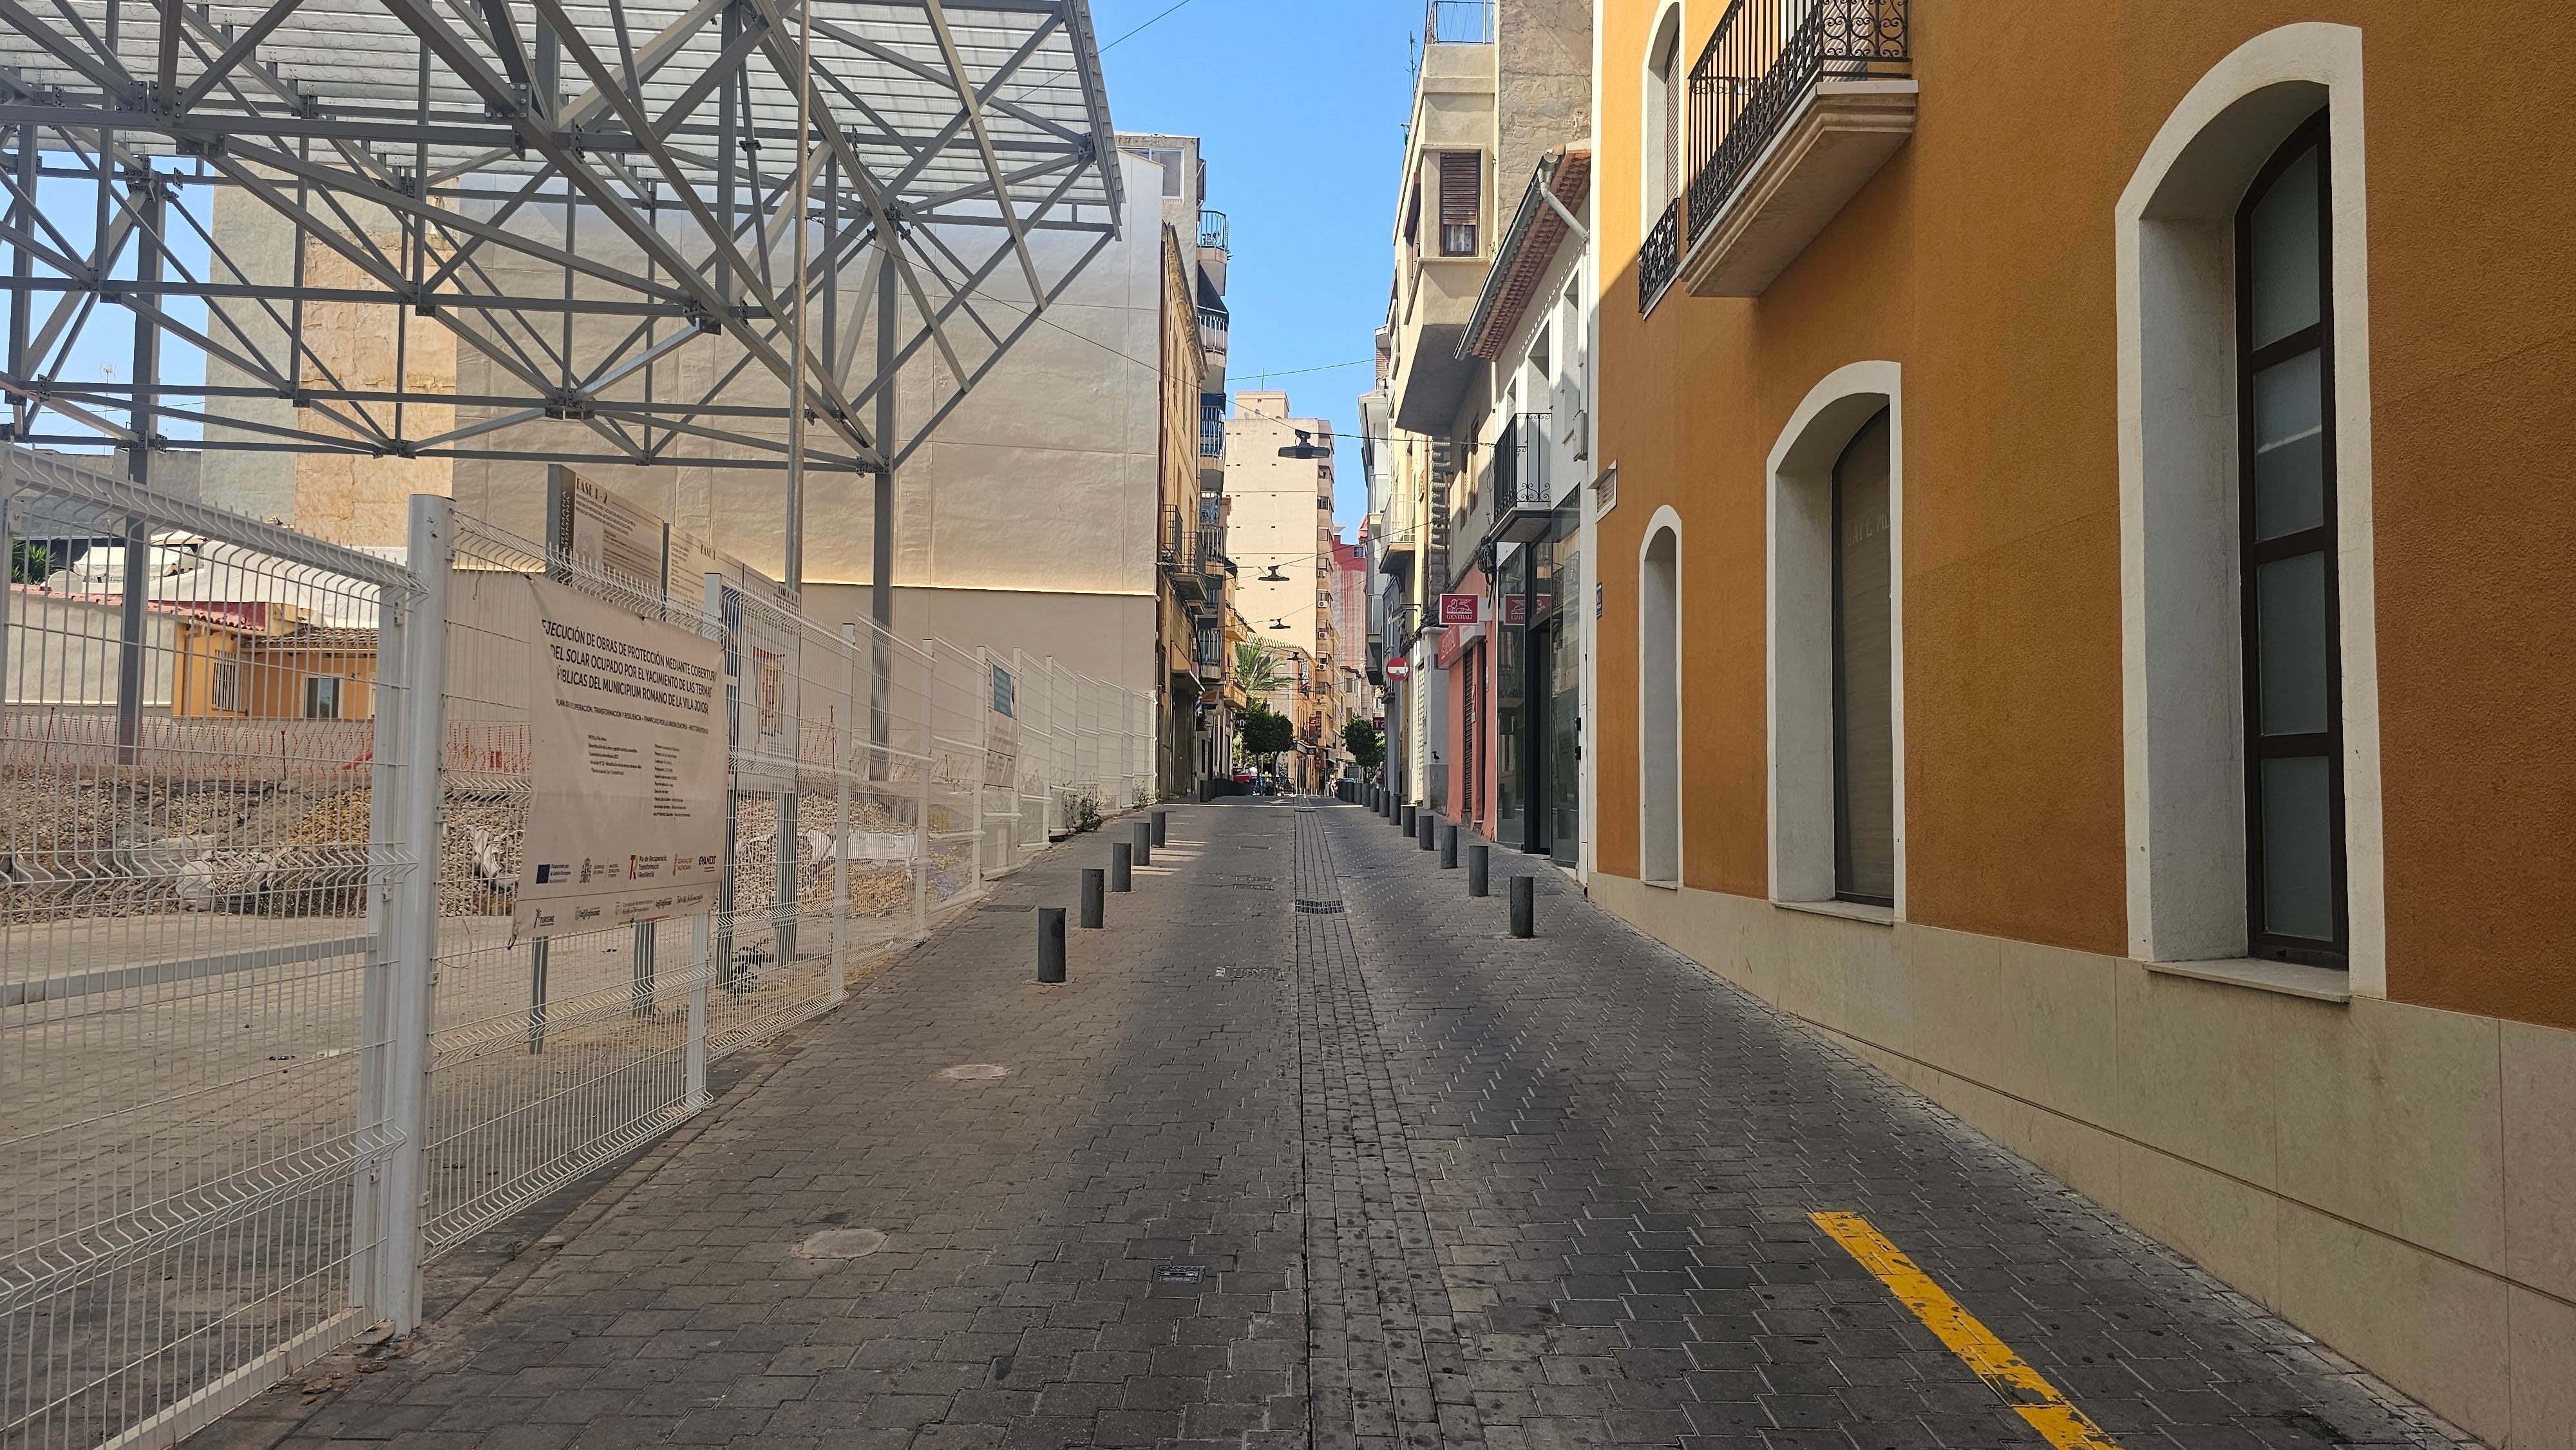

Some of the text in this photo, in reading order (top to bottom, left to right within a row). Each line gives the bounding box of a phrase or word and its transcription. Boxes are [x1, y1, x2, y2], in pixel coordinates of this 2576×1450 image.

[576, 477, 593, 498] FASE
[542, 619, 585, 645] EJECUCIÓN
[587, 632, 595, 648] DE
[596, 636, 618, 654] OBRAS
[619, 642, 627, 656] DE
[628, 645, 664, 667] PROTECCIÓN
[665, 656, 690, 675] MEDIANTE
[551, 644, 564, 661] DEL
[566, 648, 590, 667] SOLAR
[591, 655, 623, 675] OCUPADO
[624, 663, 637, 679] POR
[638, 667, 645, 681] EL
[645, 668, 678, 689] YACIMIENTO
[679, 678, 686, 691] DE
[687, 681, 695, 693] LAS
[556, 699, 565, 708] PLAN
[589, 675, 601, 690] DEL
[603, 678, 641, 699] MUNICIPIUM
[643, 687, 667, 704] ROMANO
[668, 693, 676, 706] DE
[676, 696, 683, 708] LA
[683, 697, 694, 710] VILA
